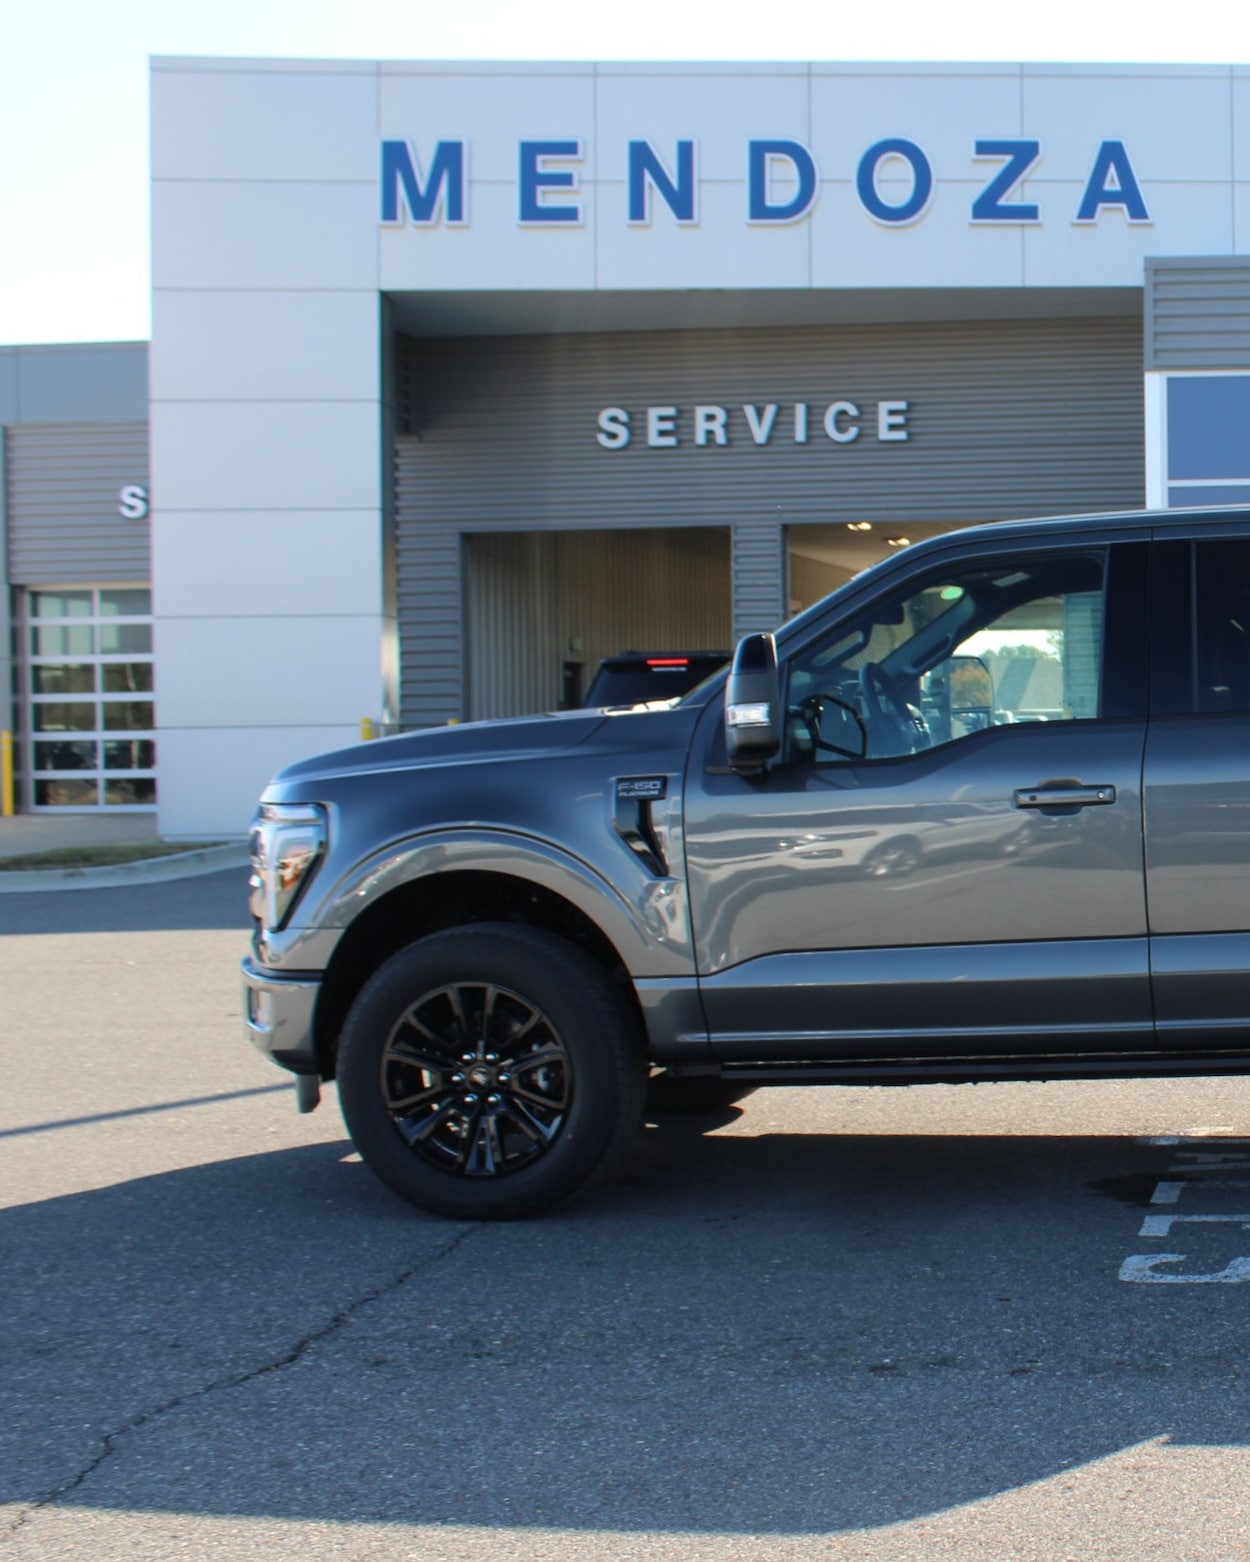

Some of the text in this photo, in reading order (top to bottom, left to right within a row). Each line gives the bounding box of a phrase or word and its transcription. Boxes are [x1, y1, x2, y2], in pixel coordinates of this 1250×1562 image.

[379, 137, 1152, 225] MENDOZA
[597, 400, 909, 448] SERVICE
[617, 781, 661, 790] F-150
